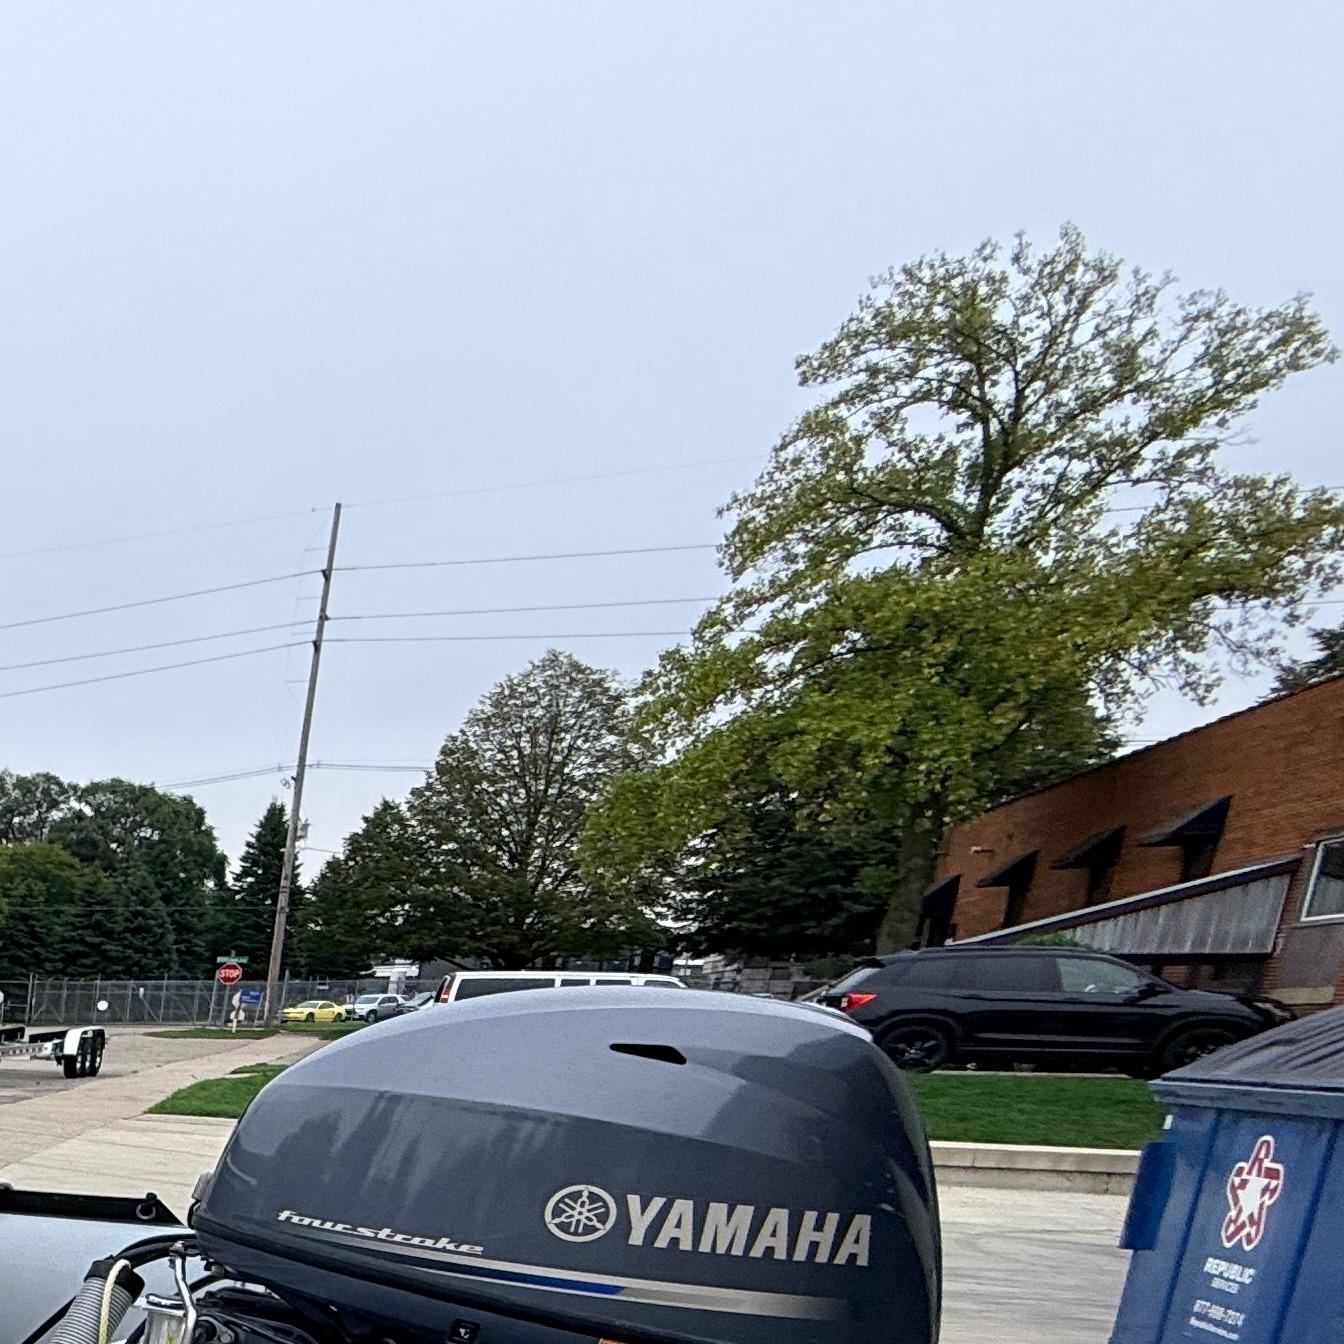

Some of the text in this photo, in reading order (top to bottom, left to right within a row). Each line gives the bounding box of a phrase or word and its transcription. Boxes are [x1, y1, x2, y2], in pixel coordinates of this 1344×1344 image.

[219, 969, 240, 979] STOP
[626, 1193, 872, 1267] YAMAHA
[1203, 1257, 1256, 1284] REPUBLIC
